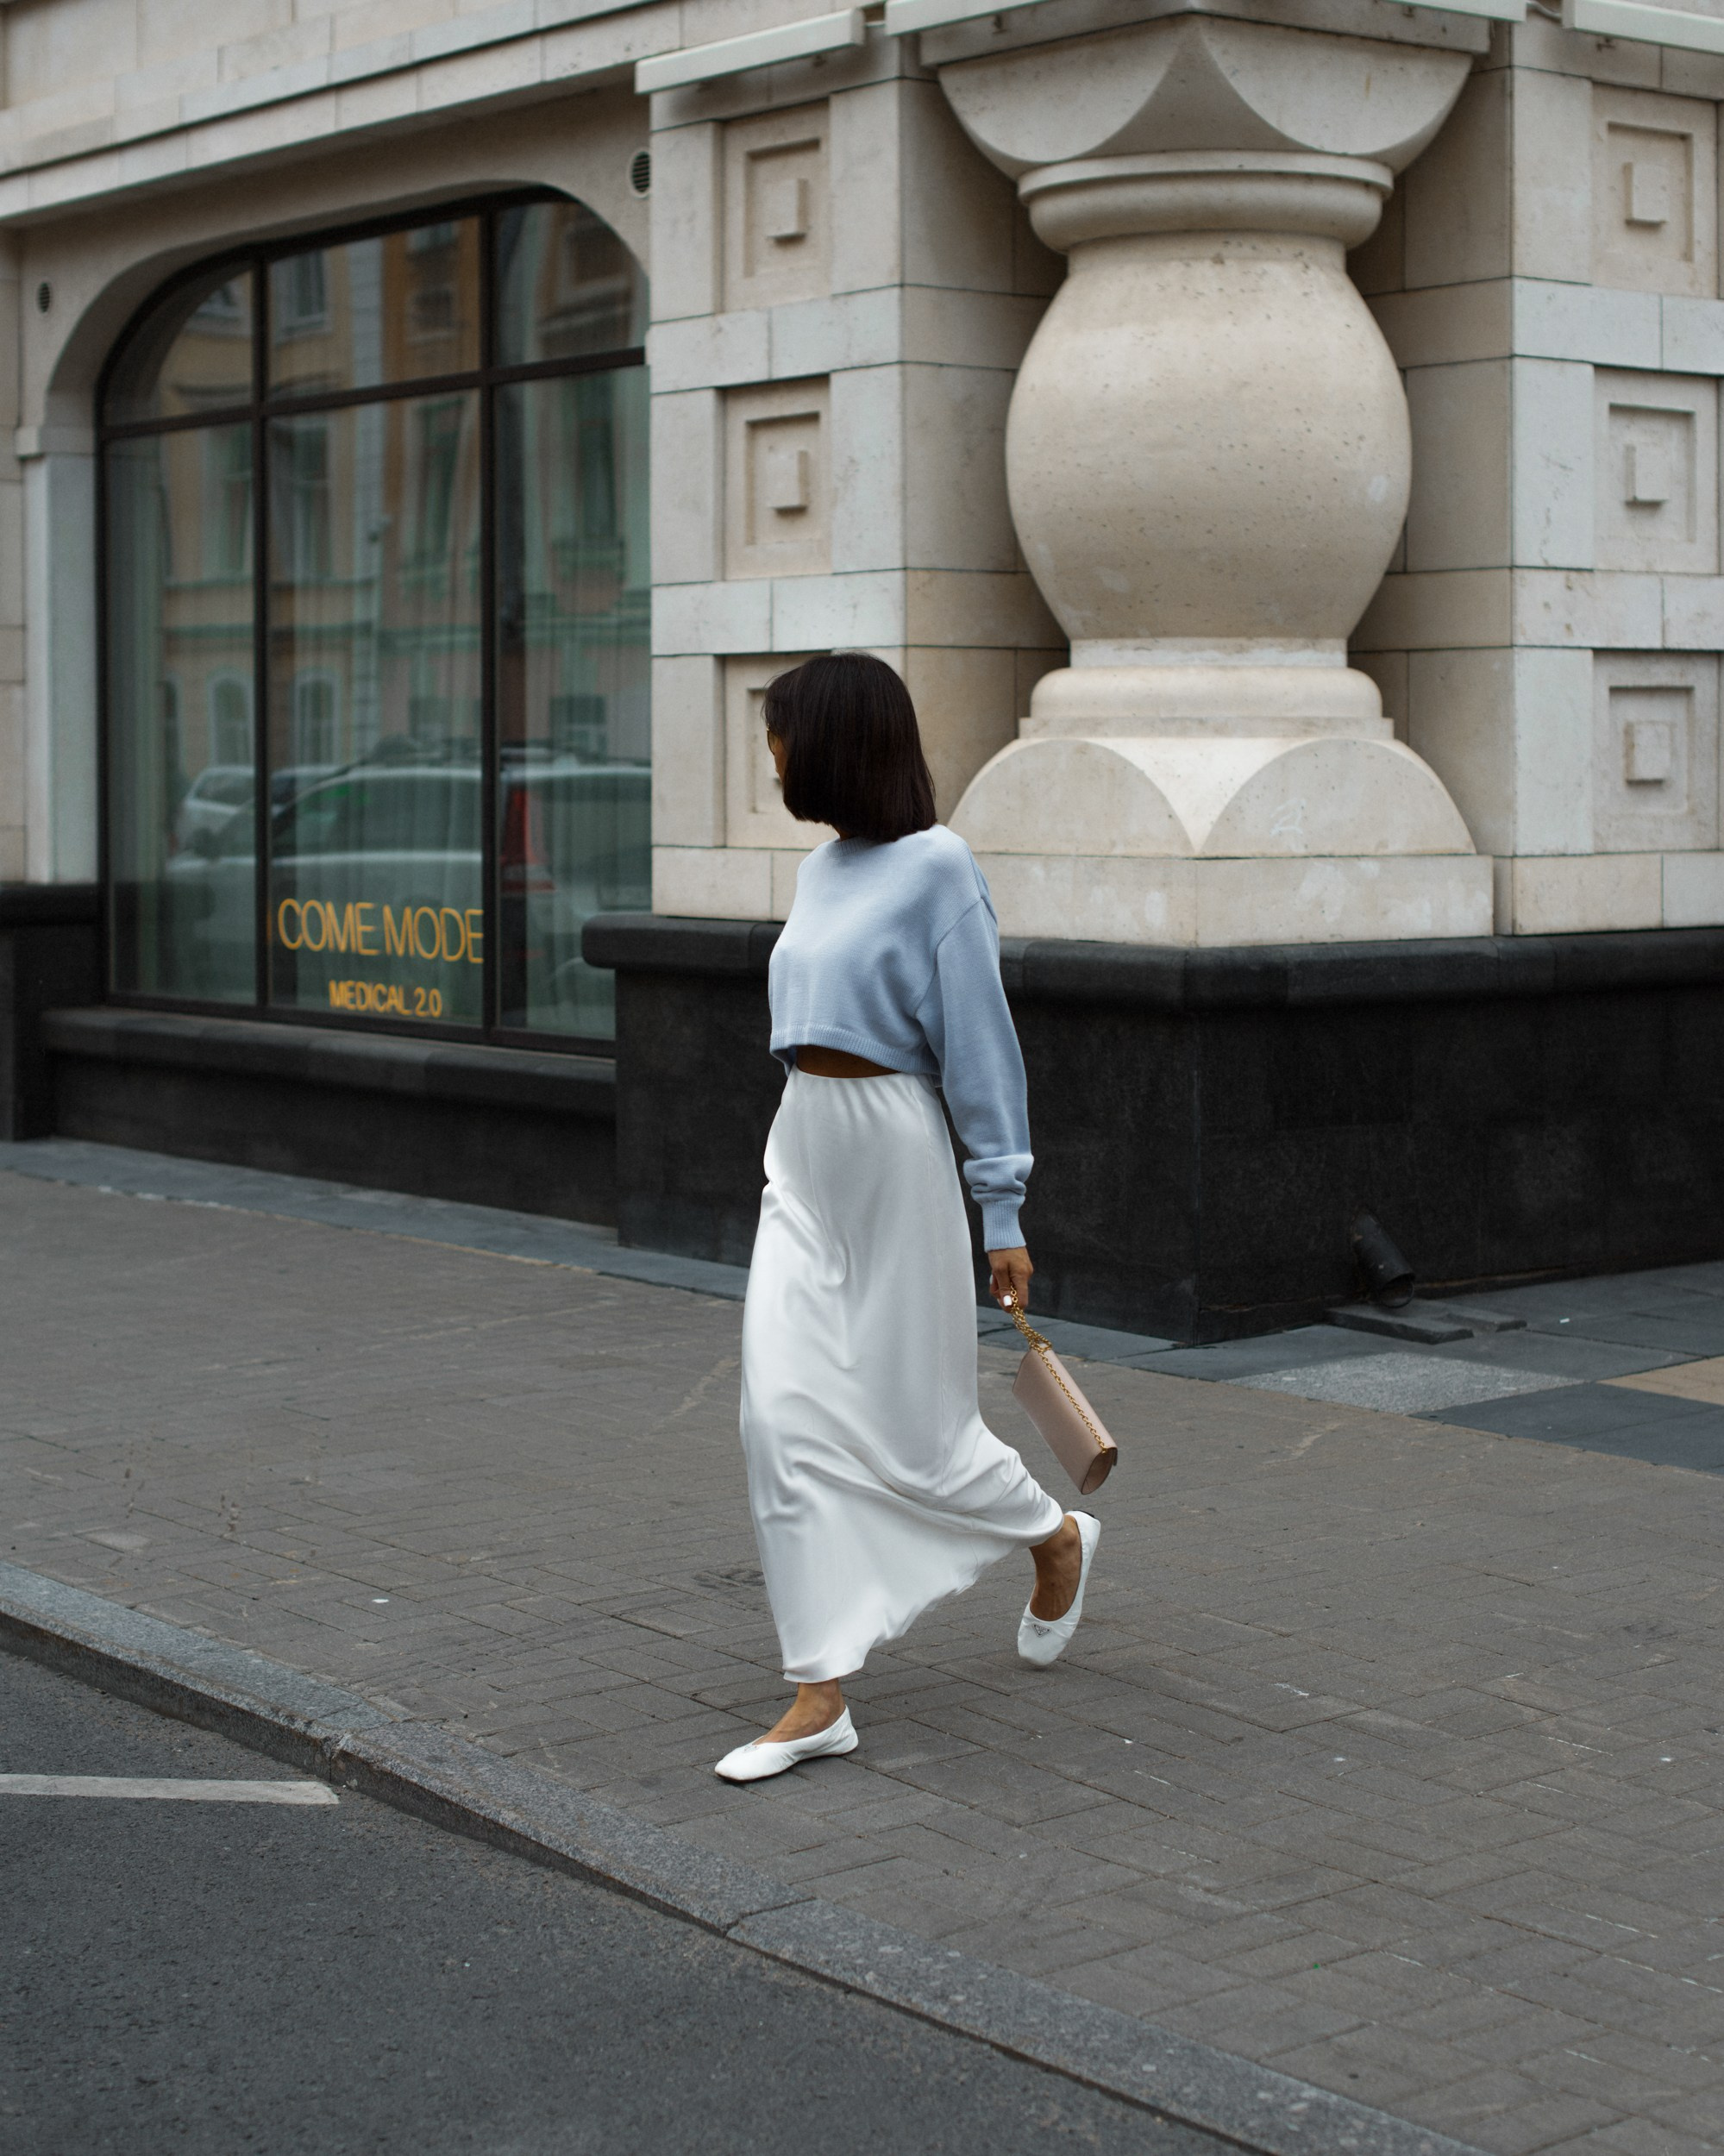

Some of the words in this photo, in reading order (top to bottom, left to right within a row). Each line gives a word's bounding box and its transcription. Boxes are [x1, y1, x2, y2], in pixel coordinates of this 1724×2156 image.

[278, 898, 379, 956] COME
[383, 904, 483, 963] MODE
[329, 979, 412, 1015] MEDICAL
